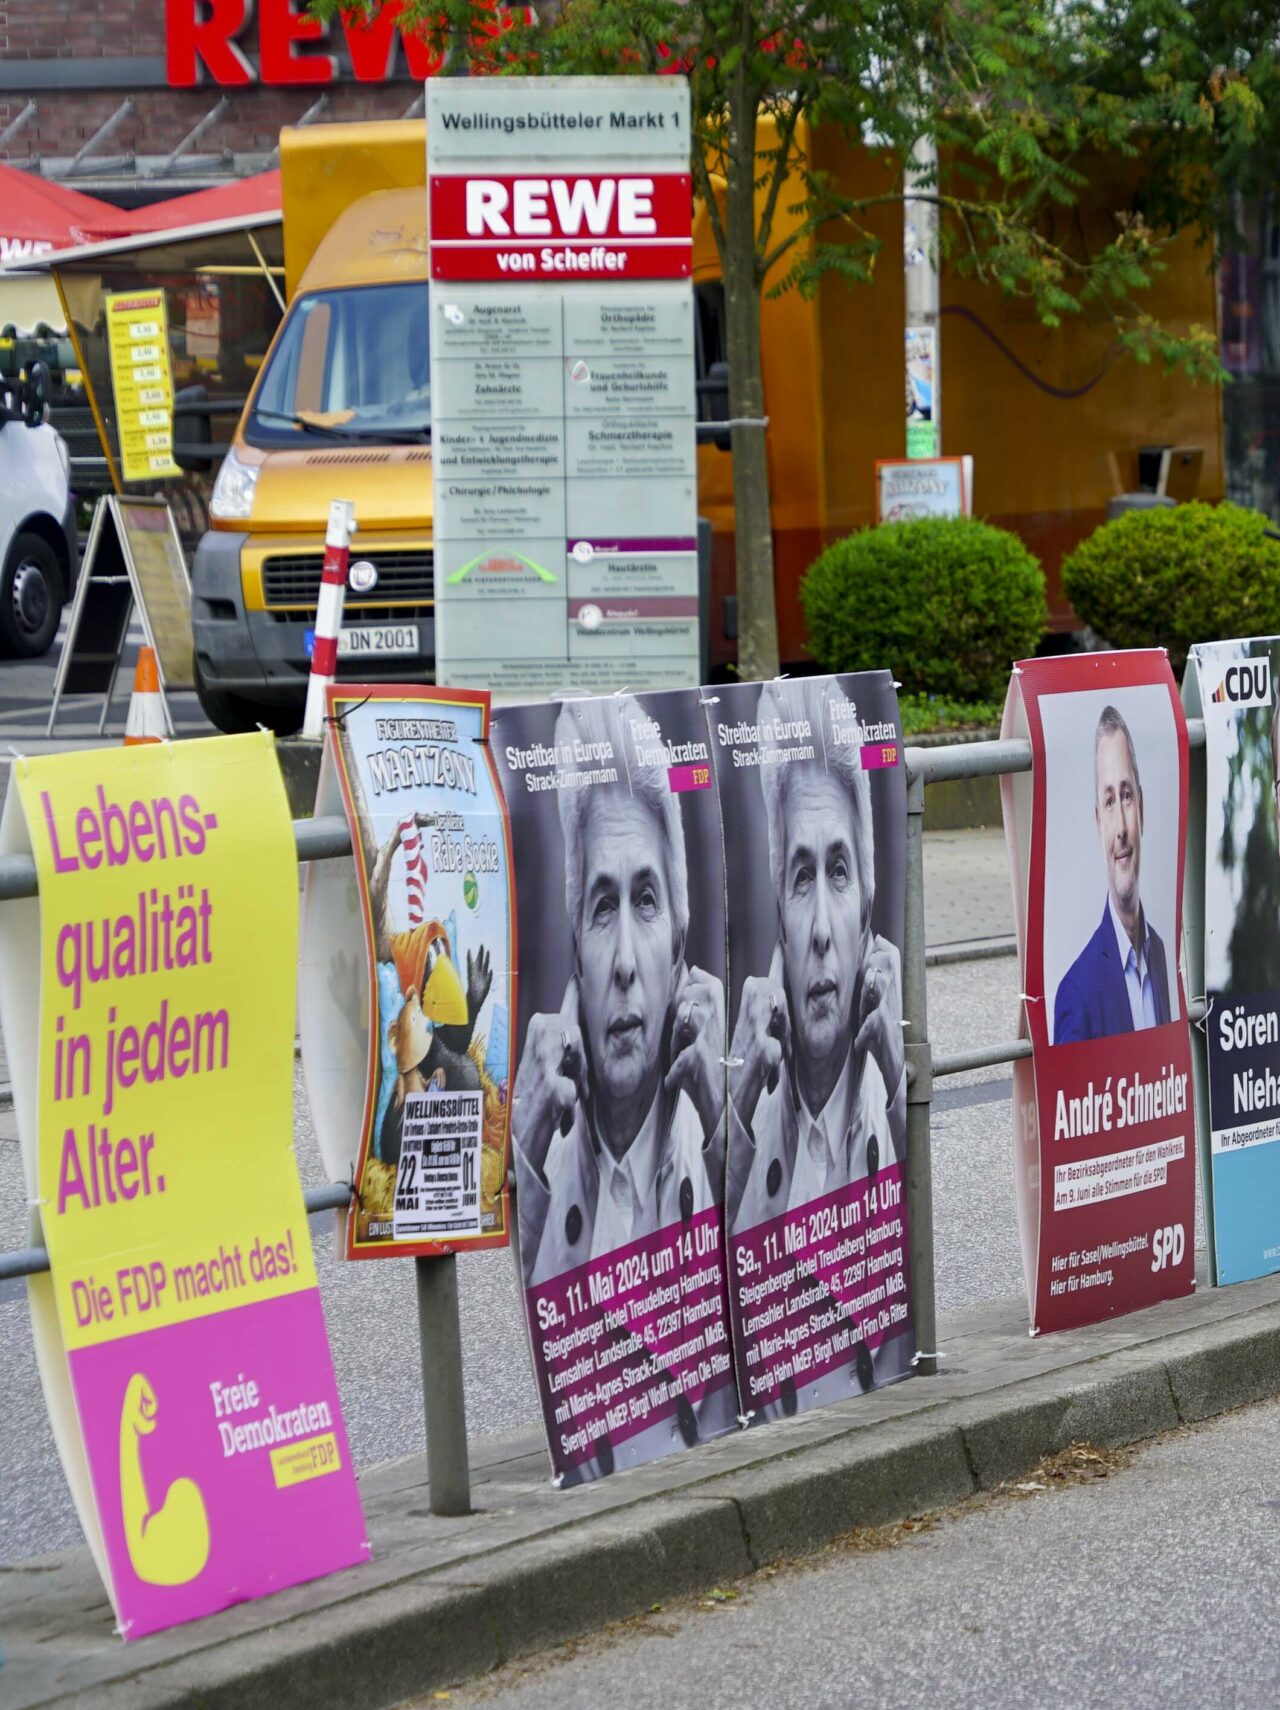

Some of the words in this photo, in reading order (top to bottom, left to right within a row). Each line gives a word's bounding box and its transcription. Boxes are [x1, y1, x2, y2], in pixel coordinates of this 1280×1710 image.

[442, 112, 603, 133] Wellingsbütteler
[610, 112, 664, 127] Markt
[671, 113, 680, 127] 1
[466, 178, 657, 236] REWE
[496, 252, 535, 271] von
[540, 247, 628, 271] Scheffer
[350, 631, 370, 650] DN
[374, 629, 415, 649] 2001
[1225, 664, 1267, 702] CDU
[829, 698, 858, 720] Freie
[375, 718, 459, 742] FIGURENTHEATER
[629, 718, 661, 740] Freie
[718, 718, 761, 747] Streitbar
[762, 722, 774, 741] in
[774, 717, 812, 742] Europa
[832, 720, 897, 745] Demokraten
[505, 736, 559, 771] Streitbar
[559, 743, 572, 766] in
[573, 738, 614, 766] Europa
[635, 740, 709, 767] Demokraten
[732, 744, 815, 768] Strack-Zimmermann
[882, 747, 897, 764] FDP
[525, 766, 618, 793] Strack-Zimmermann
[692, 768, 710, 785] FDP
[40, 784, 218, 874] Lebens-
[431, 833, 463, 873] Rabe
[463, 833, 500, 873] Socke
[56, 884, 212, 1010] qualität
[1219, 1005, 1279, 1052] Sören
[53, 1015, 92, 1102] in
[102, 1000, 230, 1116] jedem
[406, 1096, 480, 1120] WELLINGSBÜTTEL
[1054, 1076, 1112, 1141] André
[1116, 1063, 1187, 1128] Schneider
[1220, 1132, 1231, 1147] Ihr
[1231, 1123, 1275, 1147] Abgeordneter
[56, 1120, 166, 1215] Alter.
[397, 1154, 419, 1196] 22.
[462, 1151, 477, 1191] 01.
[1056, 1166, 1067, 1183] Ihr
[1067, 1153, 1135, 1182] Bezirksabgeordneter
[1135, 1150, 1145, 1168] für
[1145, 1149, 1157, 1165] den
[1156, 1142, 1185, 1163] Wahlkreis.
[395, 1197, 419, 1212] MAI
[462, 1193, 477, 1207] JUNI
[1055, 1189, 1067, 1206] Am
[1068, 1187, 1076, 1203] 9.
[1076, 1183, 1091, 1203] Juni
[1091, 1182, 1104, 1198] alle
[1104, 1175, 1132, 1196] Stimmen
[1132, 1172, 1143, 1189] für
[1143, 1170, 1153, 1186] die
[1153, 1167, 1166, 1183] SPD!
[736, 1246, 762, 1277] Sa.,
[763, 1233, 783, 1264] 11.
[784, 1218, 807, 1255] Mai
[809, 1204, 839, 1244] 2024
[840, 1199, 861, 1225] um
[863, 1189, 878, 1218] 14
[880, 1179, 902, 1209] Uhr
[738, 1269, 796, 1307] Steigenberger
[796, 1255, 818, 1279] Hotel
[818, 1235, 866, 1270] Treudelberg
[865, 1217, 903, 1247] Hamburg,
[1051, 1253, 1068, 1272] Hier
[1068, 1250, 1081, 1270] für
[1151, 1223, 1185, 1273] SPD
[71, 1277, 114, 1330] Die
[117, 1261, 166, 1318] FDP
[173, 1247, 246, 1303] macht
[249, 1229, 299, 1280] das!
[537, 1296, 567, 1331] Sa.,
[566, 1280, 588, 1316] 11.
[588, 1267, 614, 1306] Mai
[617, 1251, 649, 1294] 2024
[650, 1245, 674, 1274] um
[676, 1234, 692, 1263] 14
[694, 1224, 720, 1256] Uhr
[742, 1302, 785, 1337] Lemsahler
[785, 1280, 830, 1310] Landstraße
[830, 1273, 844, 1295] 45,
[843, 1258, 866, 1285] 22397
[866, 1246, 903, 1275] Hamburg
[1050, 1277, 1067, 1297] Hier
[1067, 1274, 1080, 1293] für
[1080, 1269, 1114, 1291] Hamburg.
[209, 1373, 260, 1418] Freie
[218, 1401, 333, 1458] Demokraten
[310, 1441, 335, 1469] FDP
